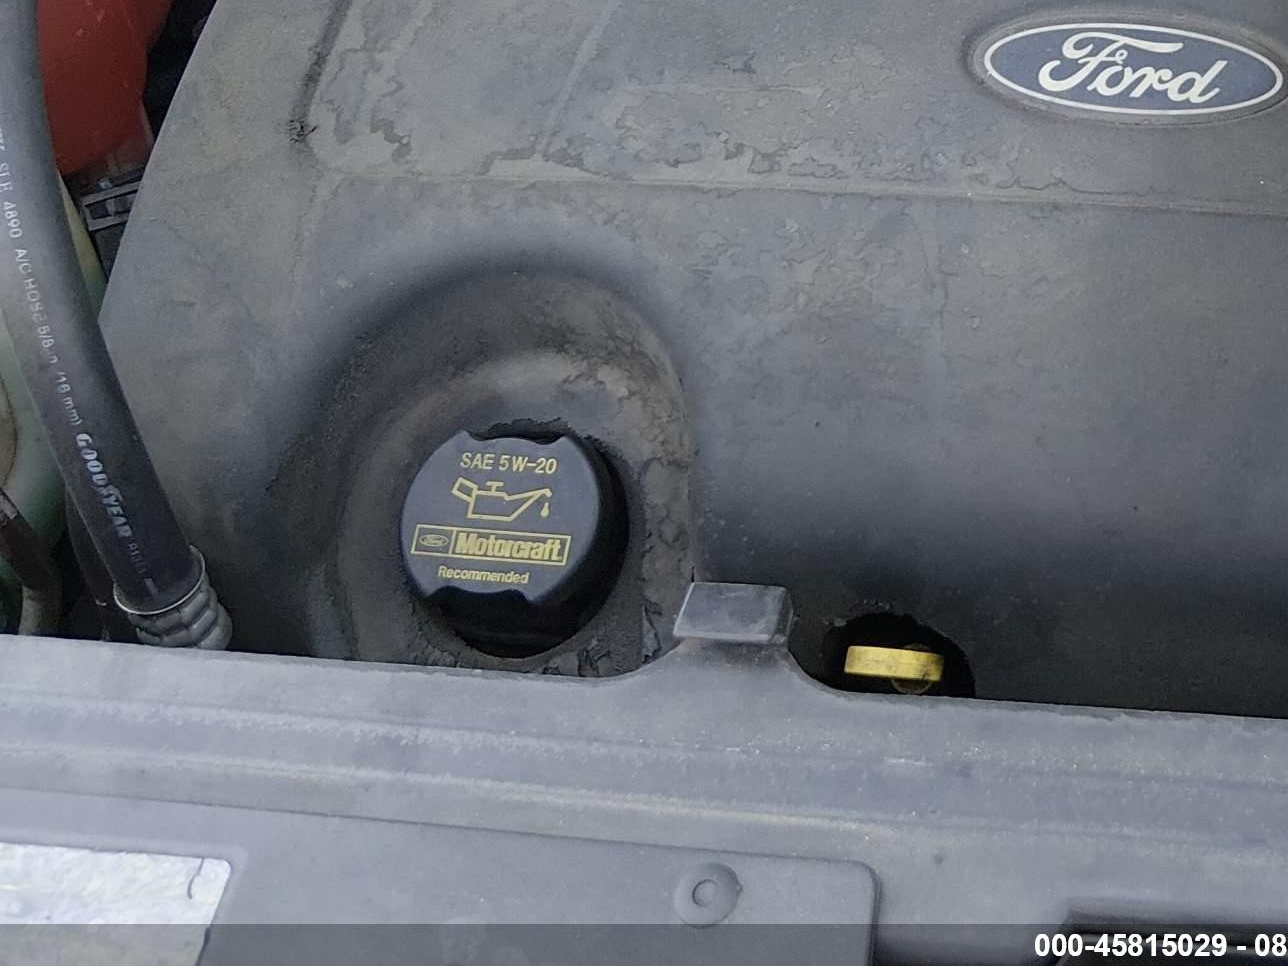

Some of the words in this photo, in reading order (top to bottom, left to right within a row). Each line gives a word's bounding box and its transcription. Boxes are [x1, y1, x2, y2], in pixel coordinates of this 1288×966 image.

[1037, 31, 1229, 104] Ford
[3, 200, 24, 239] 4890
[15, 248, 34, 275] A/C
[75, 433, 134, 538] GOODYEAR
[459, 452, 495, 471] SAE
[498, 455, 558, 475] 5W-20
[455, 532, 563, 561] Motorcraft
[437, 565, 530, 585] Recommended
